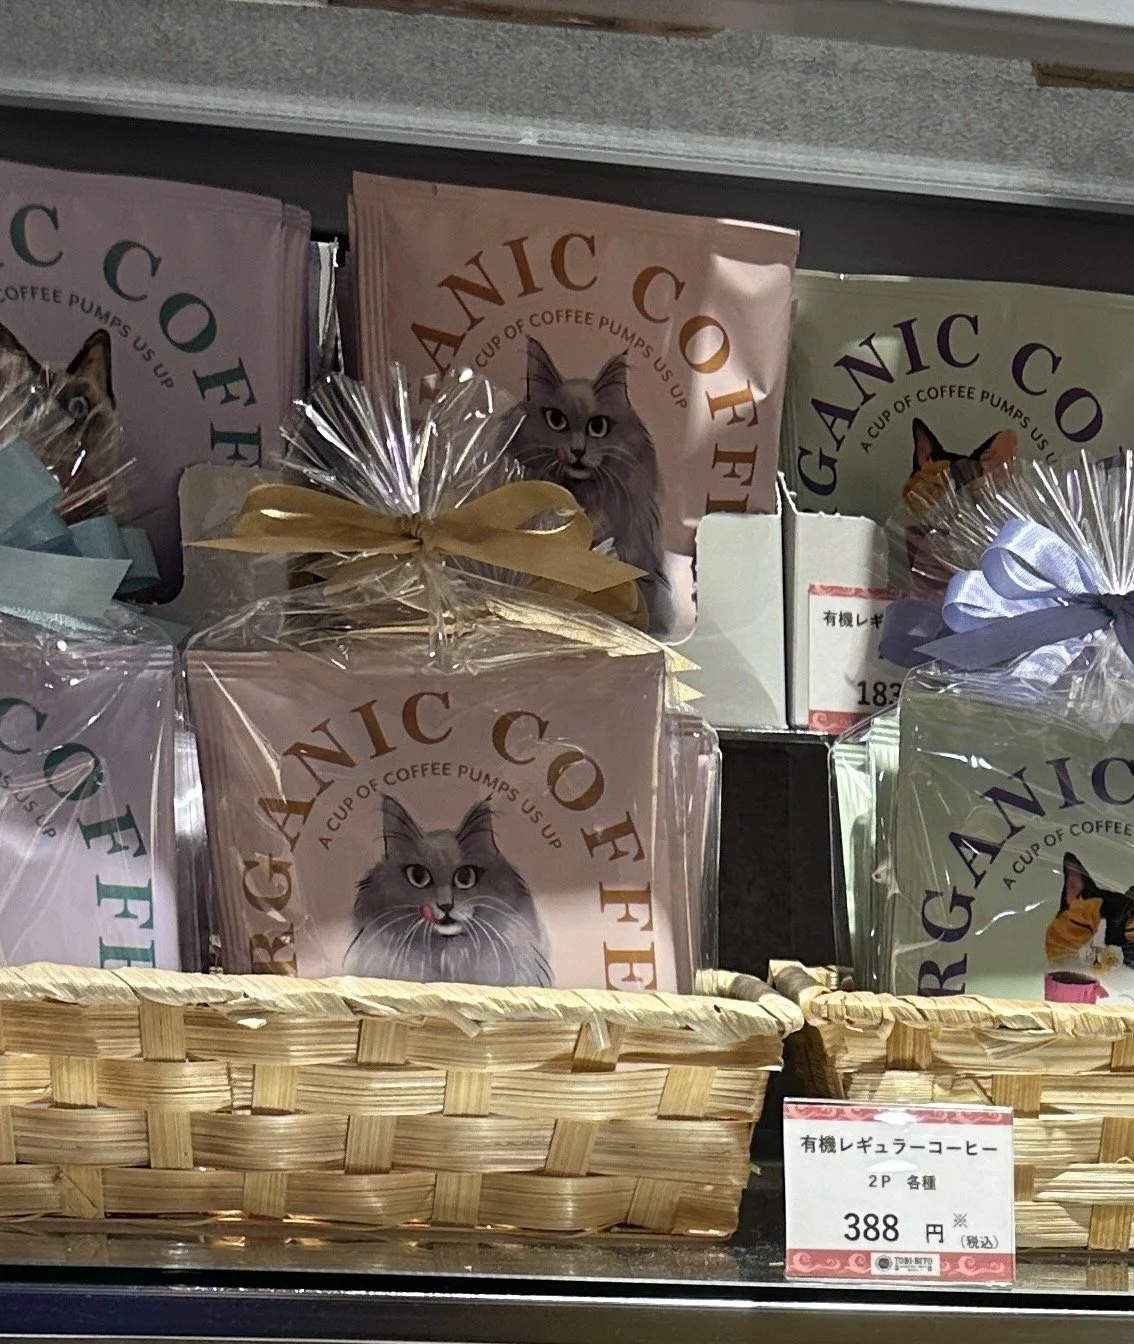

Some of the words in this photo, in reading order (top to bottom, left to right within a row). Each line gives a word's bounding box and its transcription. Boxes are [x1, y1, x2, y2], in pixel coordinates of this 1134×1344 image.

[68, 293, 131, 338] PUMPS
[133, 337, 155, 361] US
[153, 364, 174, 388] UP
[475, 335, 501, 368] CUP
[504, 319, 526, 339] OF
[529, 308, 594, 328] COFFEE
[600, 316, 653, 358] PUMPS
[654, 357, 674, 382] US
[670, 384, 688, 409] UP
[860, 441, 873, 454] A
[867, 410, 891, 438] CUP
[893, 395, 912, 413] OF
[916, 384, 976, 403] COFFEE
[980, 390, 1032, 429] PUMPS
[1030, 427, 1048, 451] US
[318, 836, 333, 850] A
[326, 797, 353, 832] CUP
[356, 779, 379, 800] OF
[383, 763, 452, 786] COFFEE
[458, 764, 519, 802] PUMPS
[521, 798, 544, 825] US
[541, 824, 562, 850] UP
[1002, 877, 1016, 891] A
[1012, 843, 1041, 875] CUP
[1043, 829, 1066, 848] OF
[1069, 820, 1133, 837] COFFEE
[800, 1135, 998, 1156] 有機レギュラーコーヒー
[869, 1174, 891, 1188] 2P
[906, 1175, 937, 1191] 各種
[843, 1212, 899, 1242] 388
[925, 1223, 944, 1244] 円
